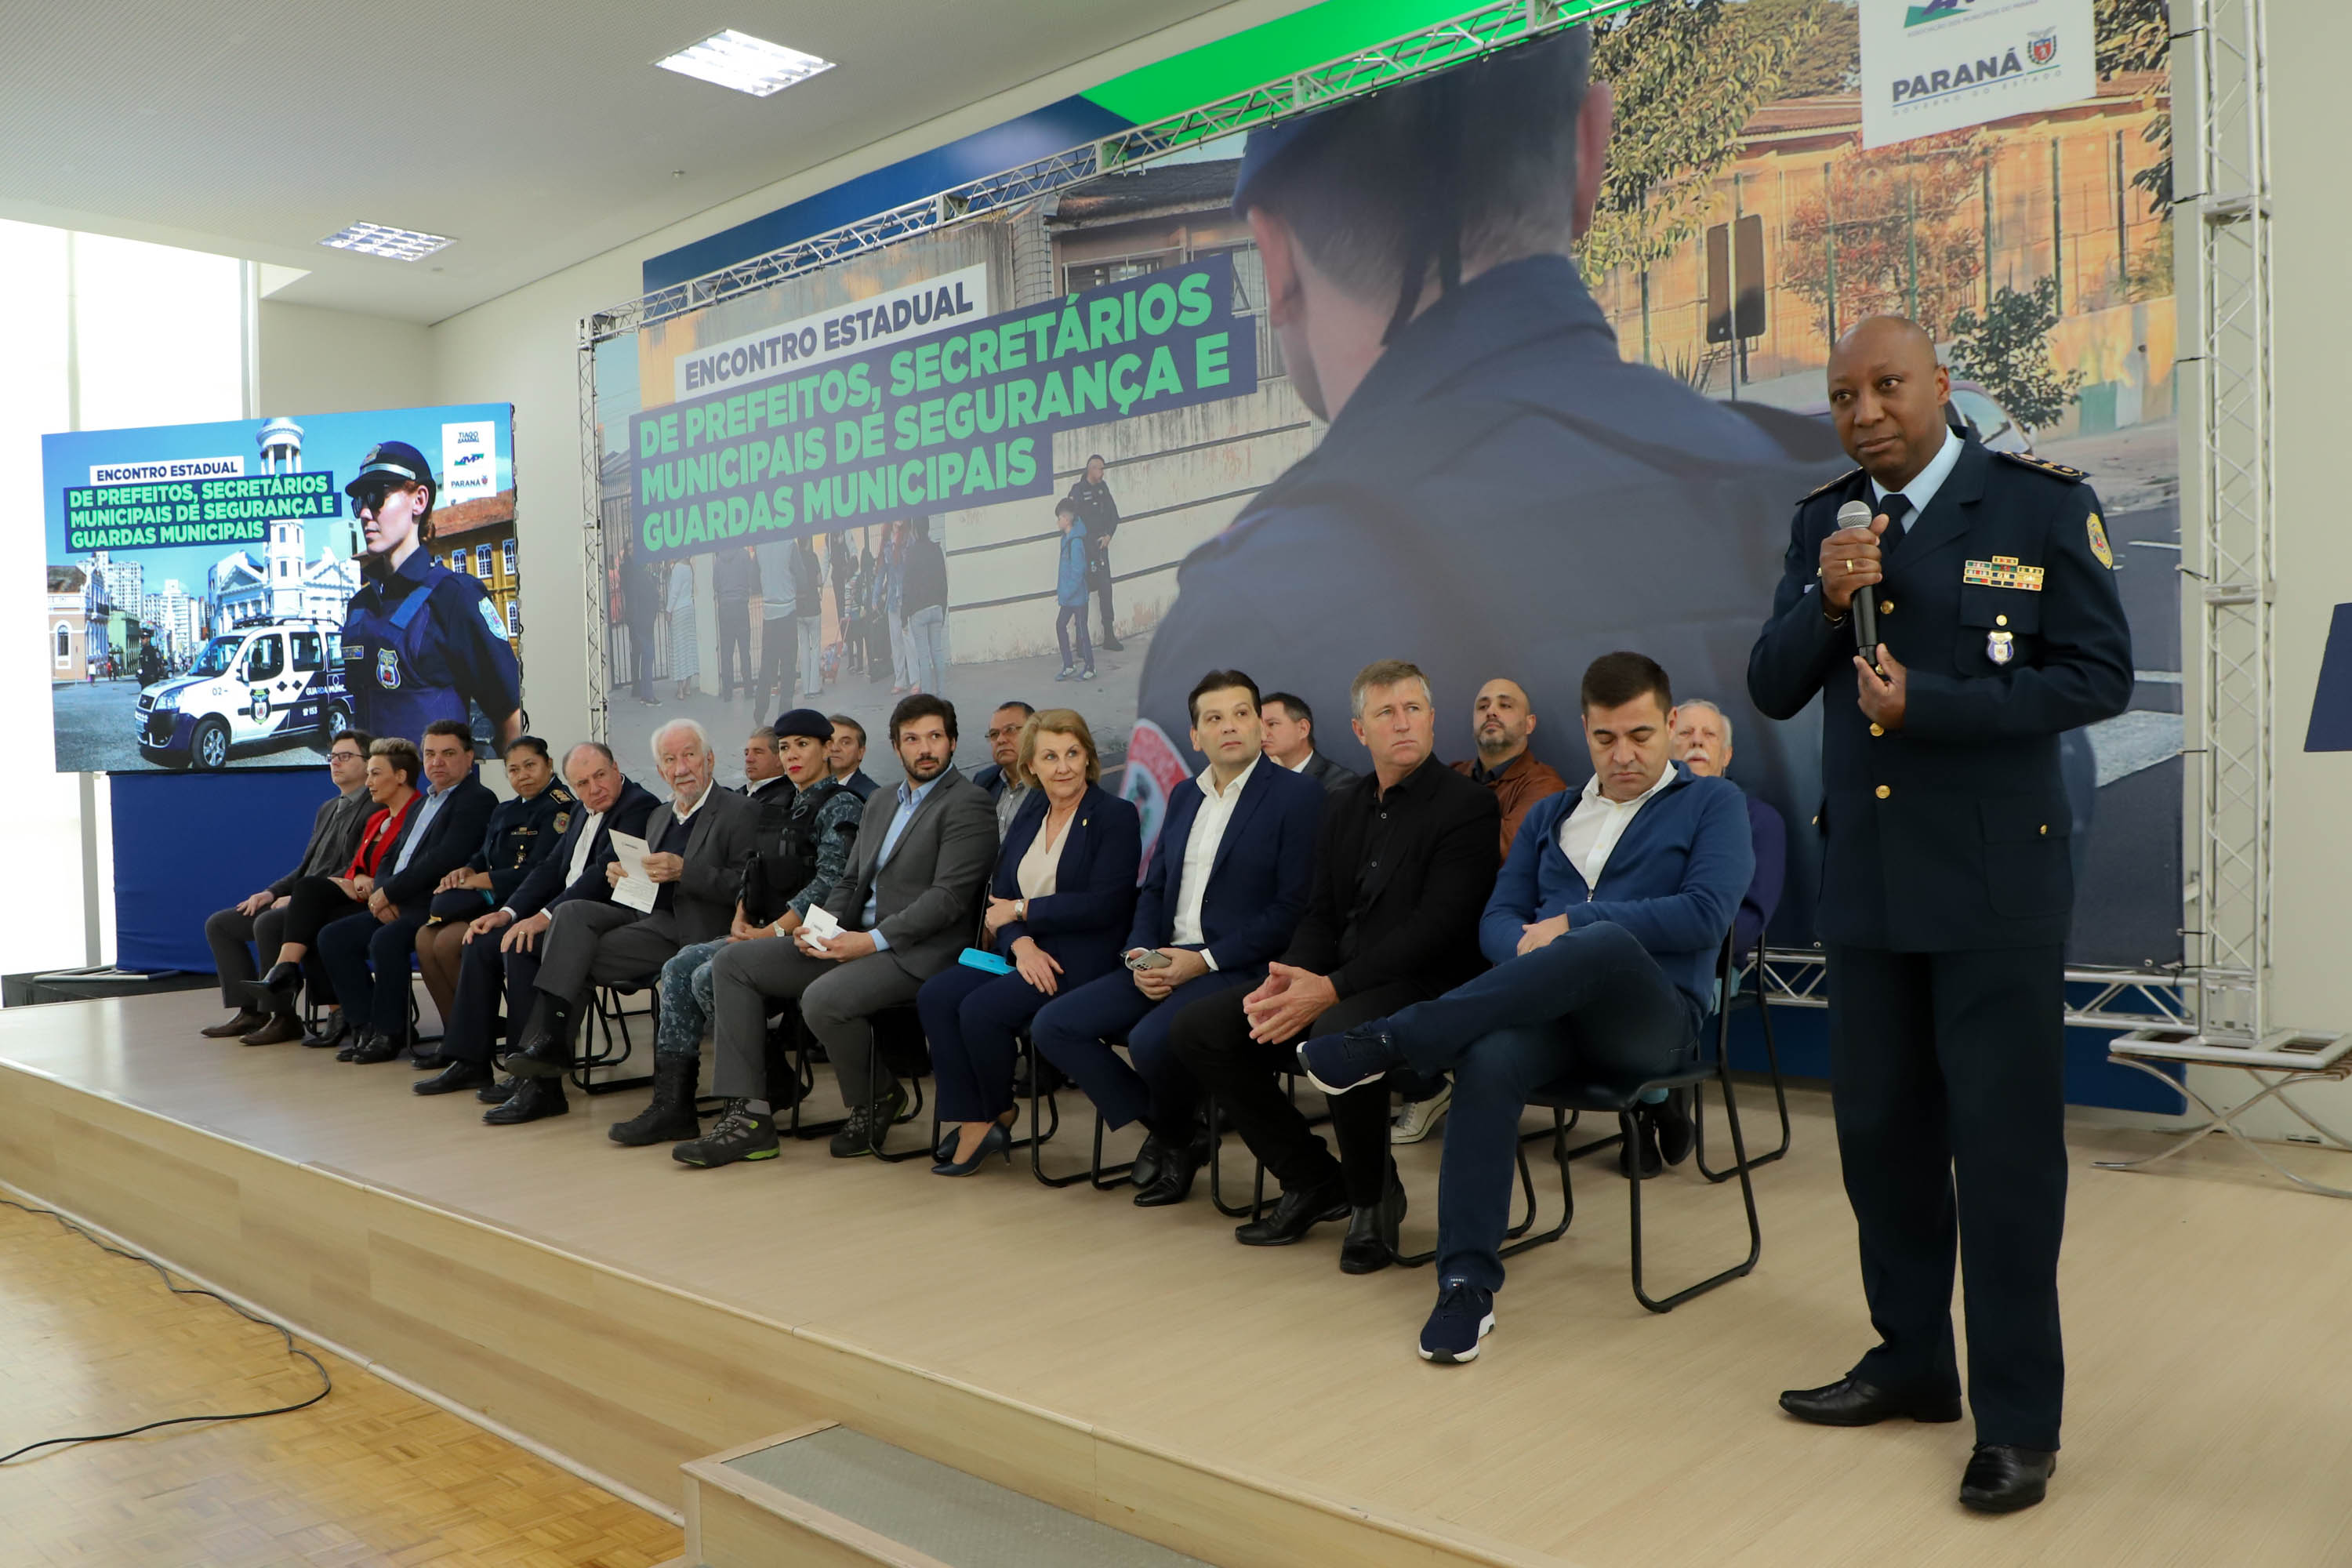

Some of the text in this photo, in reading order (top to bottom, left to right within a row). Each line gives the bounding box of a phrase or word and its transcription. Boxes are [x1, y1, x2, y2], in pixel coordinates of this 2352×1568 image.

[1893, 47, 2023, 102] PARANÁ
[684, 281, 974, 390] ENCONTRO ESTADUAL
[640, 273, 1213, 459] DE PREFEITOS, SECRETÁRIOS
[641, 332, 1230, 505] MUNICIPAIS DE SEGURANÇA E
[70, 474, 328, 507] DE PREFEITOS, SECRETÁRIOS
[97, 462, 238, 482] ENCONTRO ESTADUAL
[643, 437, 1036, 551] GUARDAS MUNICIPAIS
[71, 495, 333, 528] MUNICIPAIS DE SEGURANÇA E
[71, 521, 264, 549] GUARDAS MUNICIPAIS
[306, 685, 328, 696] GUARDA
